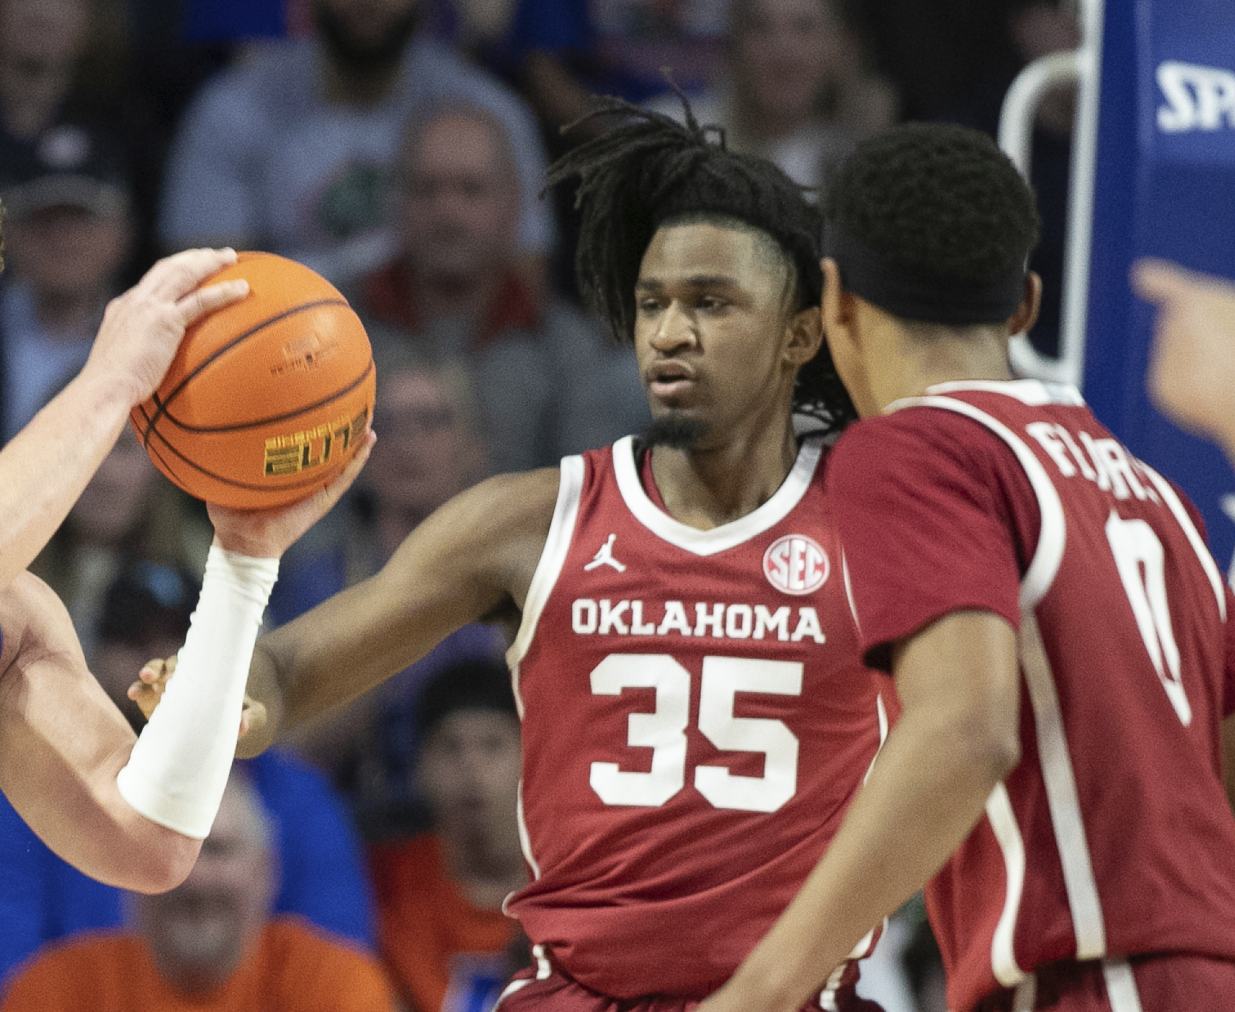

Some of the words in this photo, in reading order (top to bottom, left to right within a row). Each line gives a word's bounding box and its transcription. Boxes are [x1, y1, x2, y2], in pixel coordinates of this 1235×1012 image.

[766, 538, 826, 592] SEC
[572, 598, 826, 644] OKLAHOMA
[589, 653, 804, 813] 35
